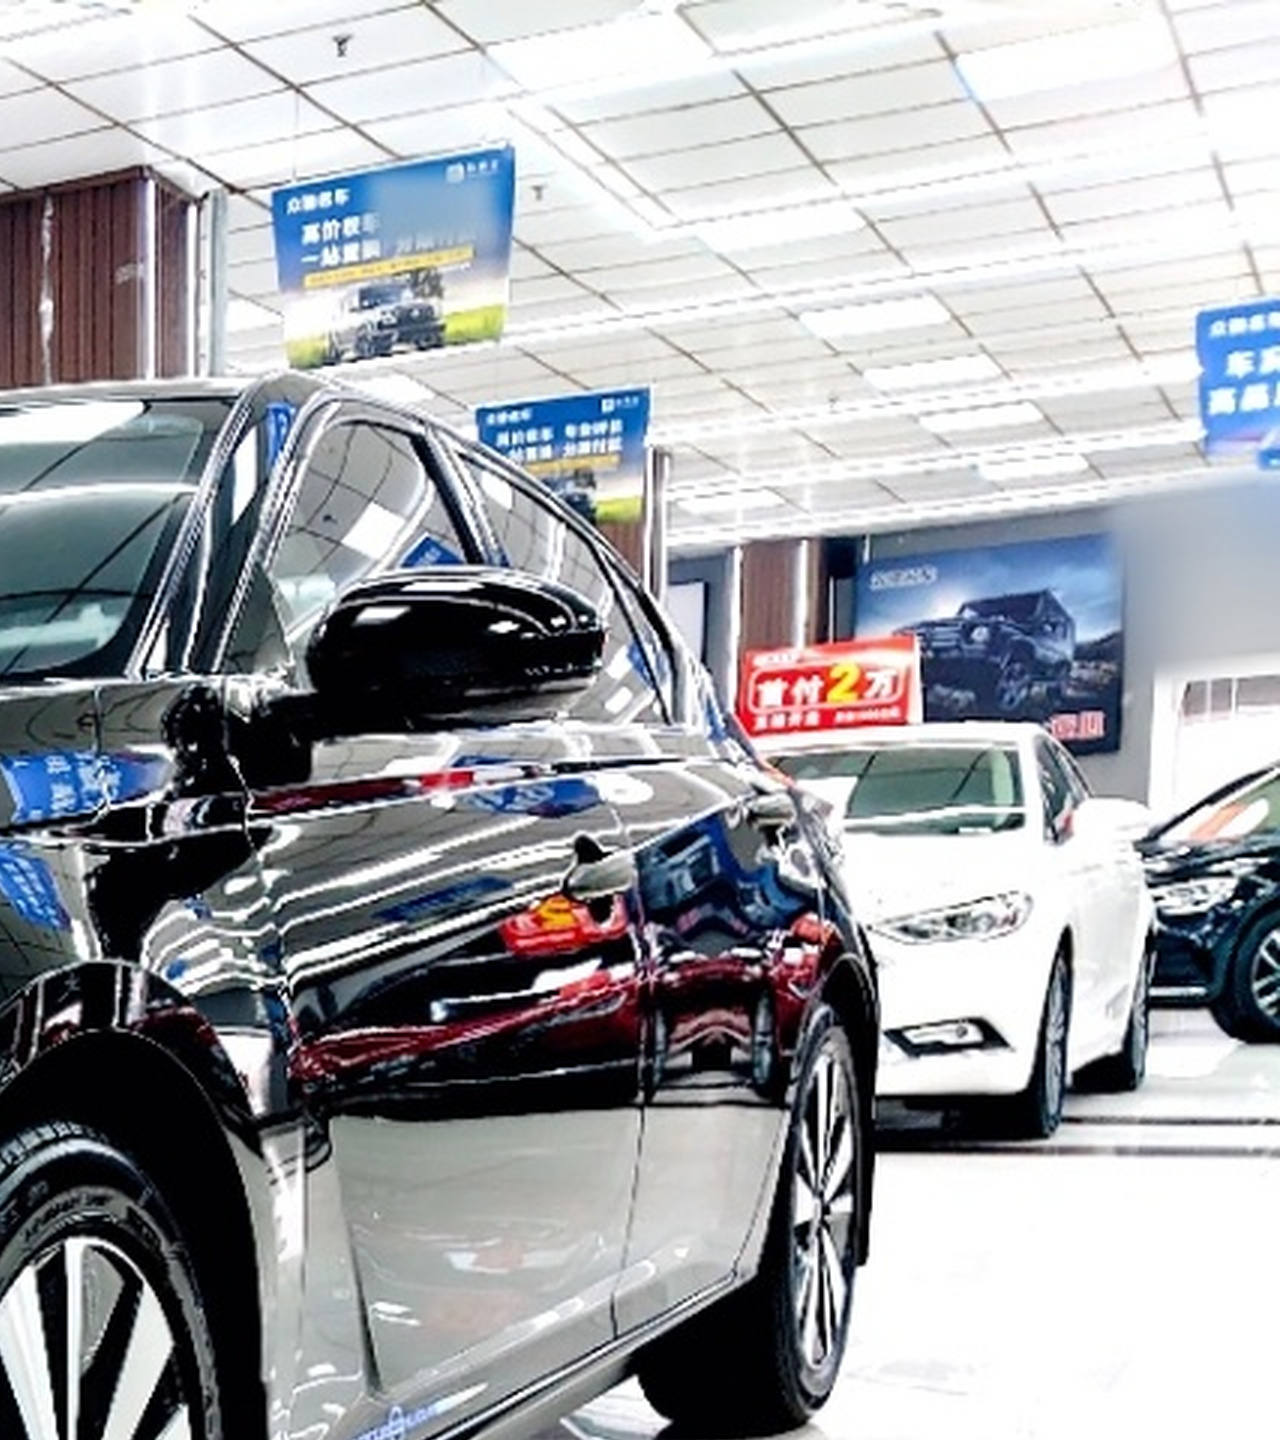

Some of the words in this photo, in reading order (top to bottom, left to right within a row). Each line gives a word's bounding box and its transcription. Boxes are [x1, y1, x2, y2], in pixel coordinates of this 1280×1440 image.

[1209, 382, 1280, 415] 高品
[506, 444, 552, 463] 站置换
[756, 661, 899, 707] 首付2万
